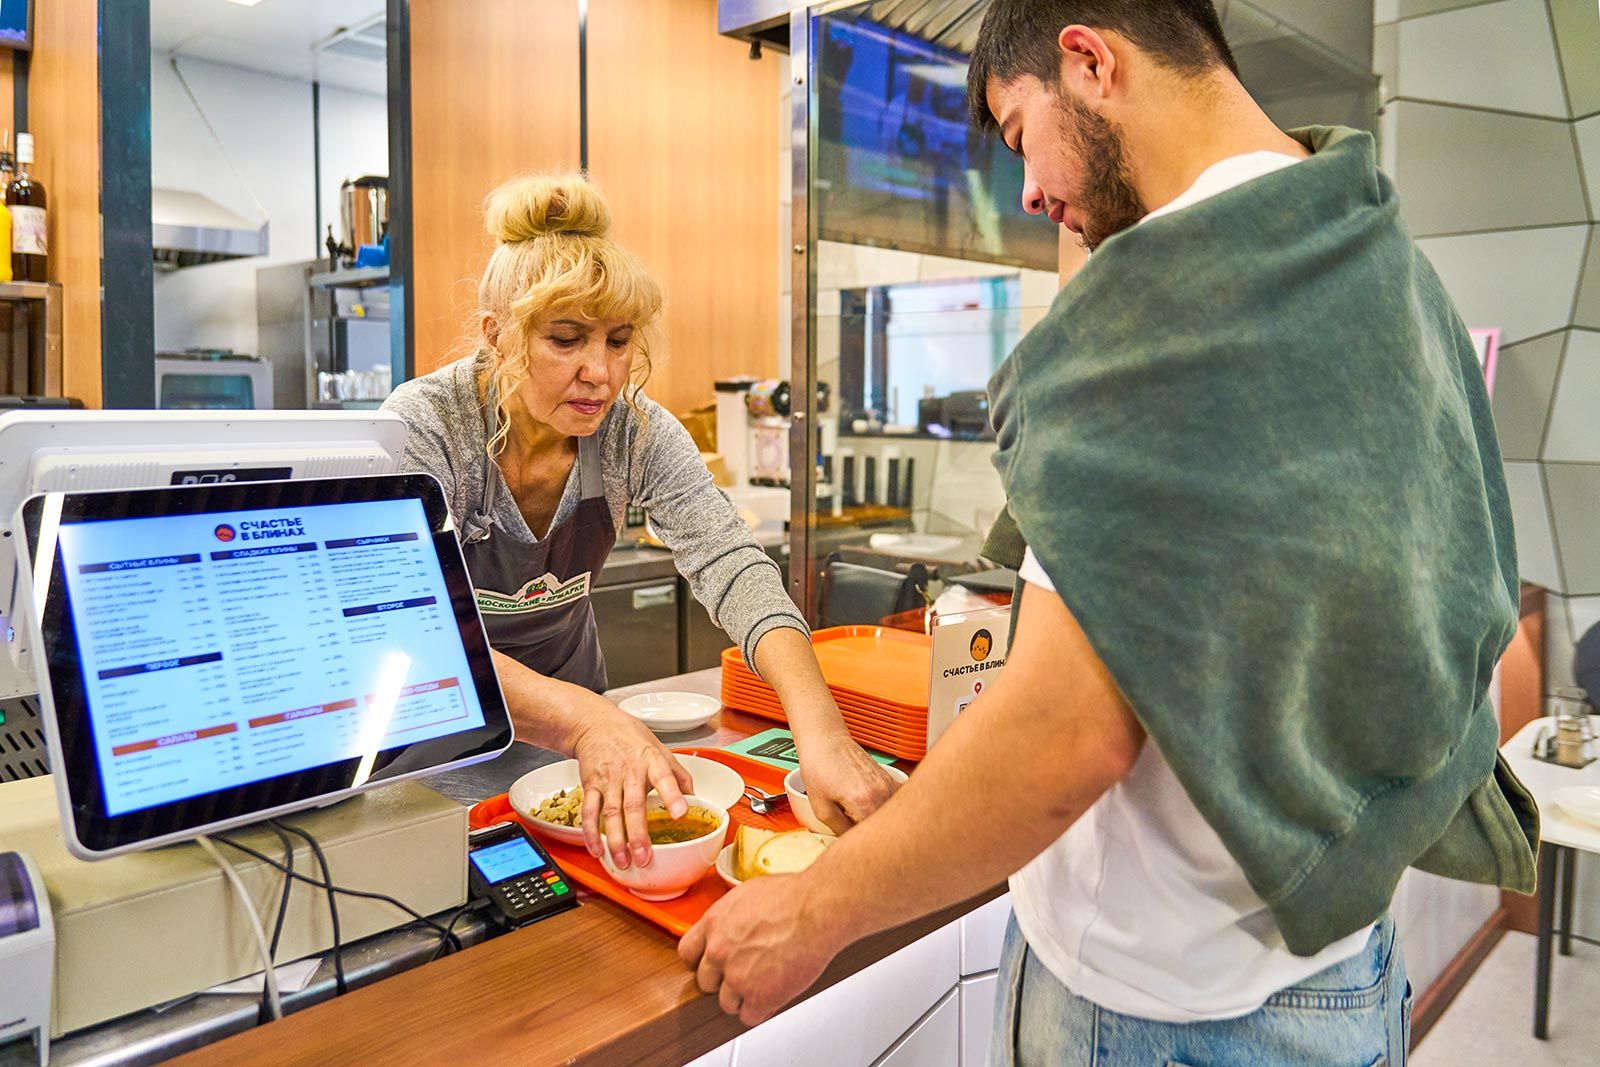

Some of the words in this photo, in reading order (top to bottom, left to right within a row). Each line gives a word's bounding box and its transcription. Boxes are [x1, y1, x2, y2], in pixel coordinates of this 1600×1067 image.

[240, 517, 303, 530] СЧАСТЬЕ
[241, 532, 250, 541] В
[252, 527, 306, 540] БЛИНАХ
[233, 548, 270, 558] СЛАДКИЕ
[271, 545, 299, 554] БЛИНЫ
[109, 559, 146, 570] СЫТНЫЕ
[148, 557, 179, 566] БЛИНЫ
[477, 596, 541, 609] МОСКОВСКИЕ
[546, 583, 585, 602] ЯРМАРКИ
[943, 663, 979, 678] СЧАСТЬЕ
[979, 662, 985, 671] В
[985, 657, 1007, 670] БЛИН
